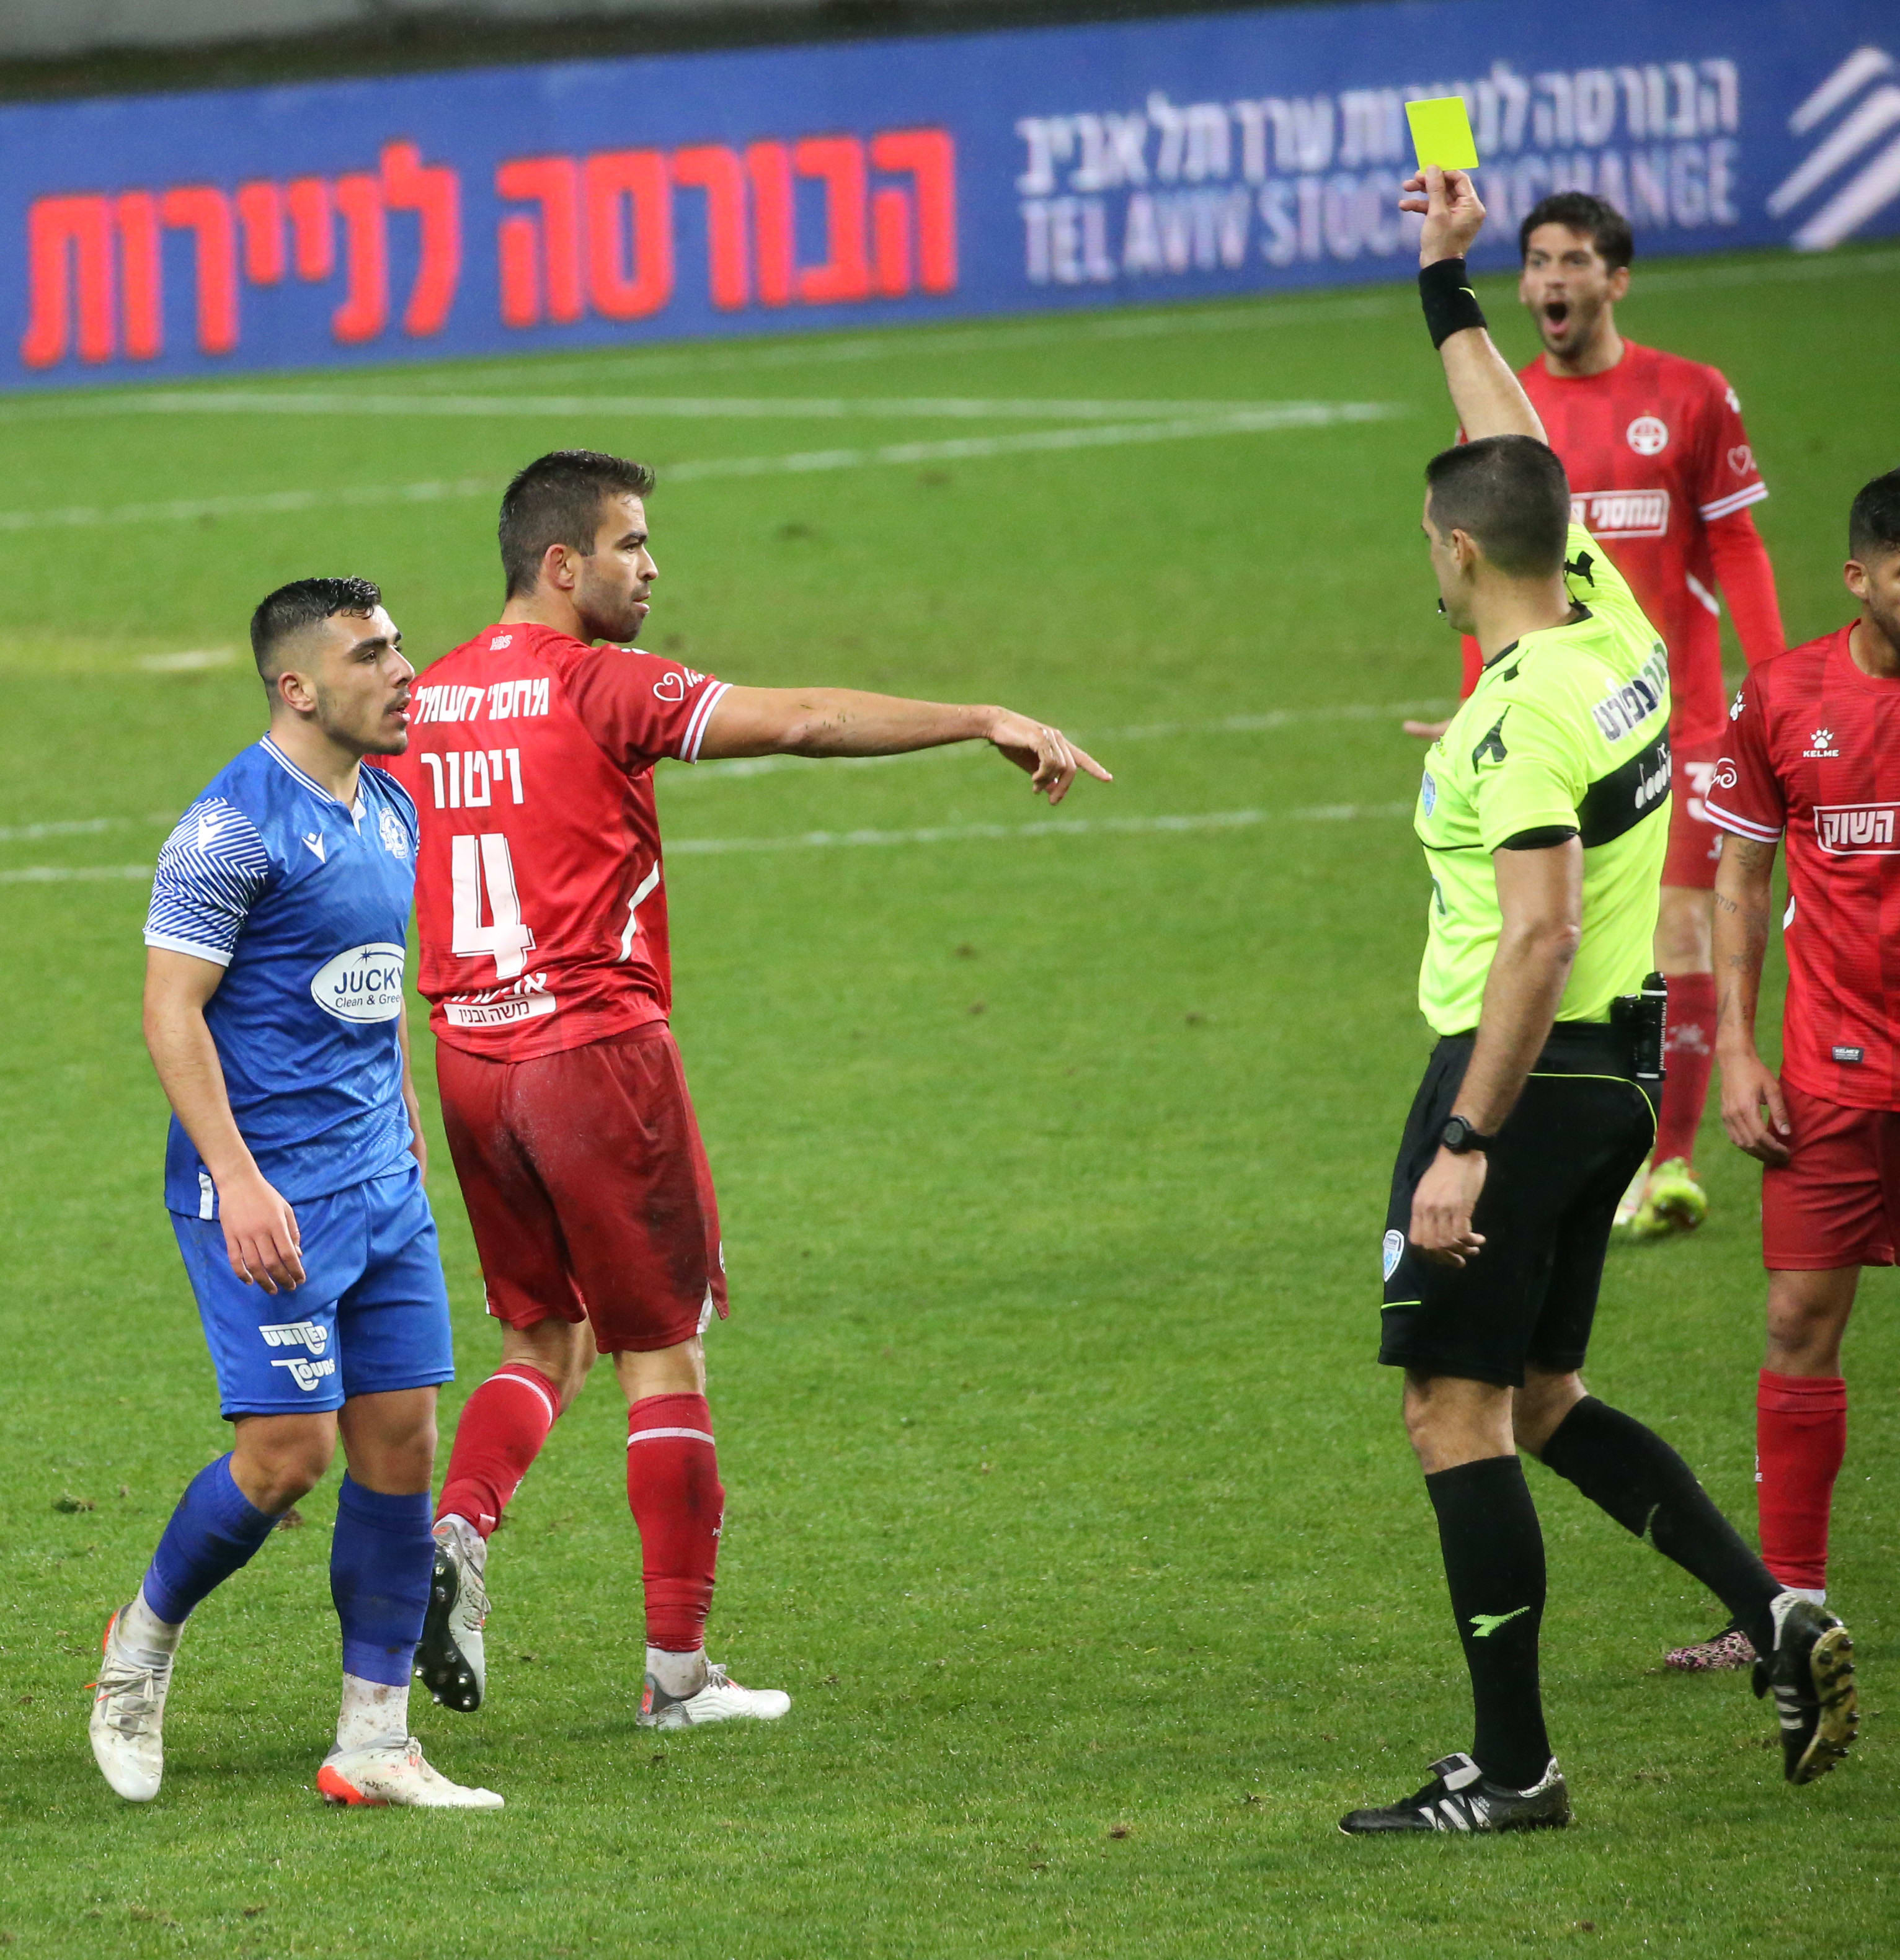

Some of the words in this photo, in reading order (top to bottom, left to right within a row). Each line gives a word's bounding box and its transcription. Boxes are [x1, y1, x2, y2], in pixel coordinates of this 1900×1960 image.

[1533, 57, 1739, 149] הבורסה
[1014, 110, 1148, 197] אביב
[1145, 88, 1233, 184] תל
[1229, 94, 1334, 185] ערך
[496, 127, 955, 327] הבורסה
[1022, 195, 1116, 285] TEL
[1121, 185, 1251, 277] AVIV
[21, 140, 460, 367] לניירות
[1590, 497, 1663, 529] מחסני
[414, 685, 486, 725] חשמל
[487, 677, 549, 720] מחסני
[1803, 749, 1839, 757] KELME
[420, 748, 525, 809] ויטור
[1821, 810, 1895, 848] השוק
[451, 833, 536, 980] 4
[335, 997, 363, 1008] Clean
[366, 994, 376, 1005] &
[459, 1008, 487, 1023] ובניו
[488, 1000, 530, 1022] משה
[259, 1321, 327, 1355] UNITED
[270, 1357, 336, 1391] TOURS
